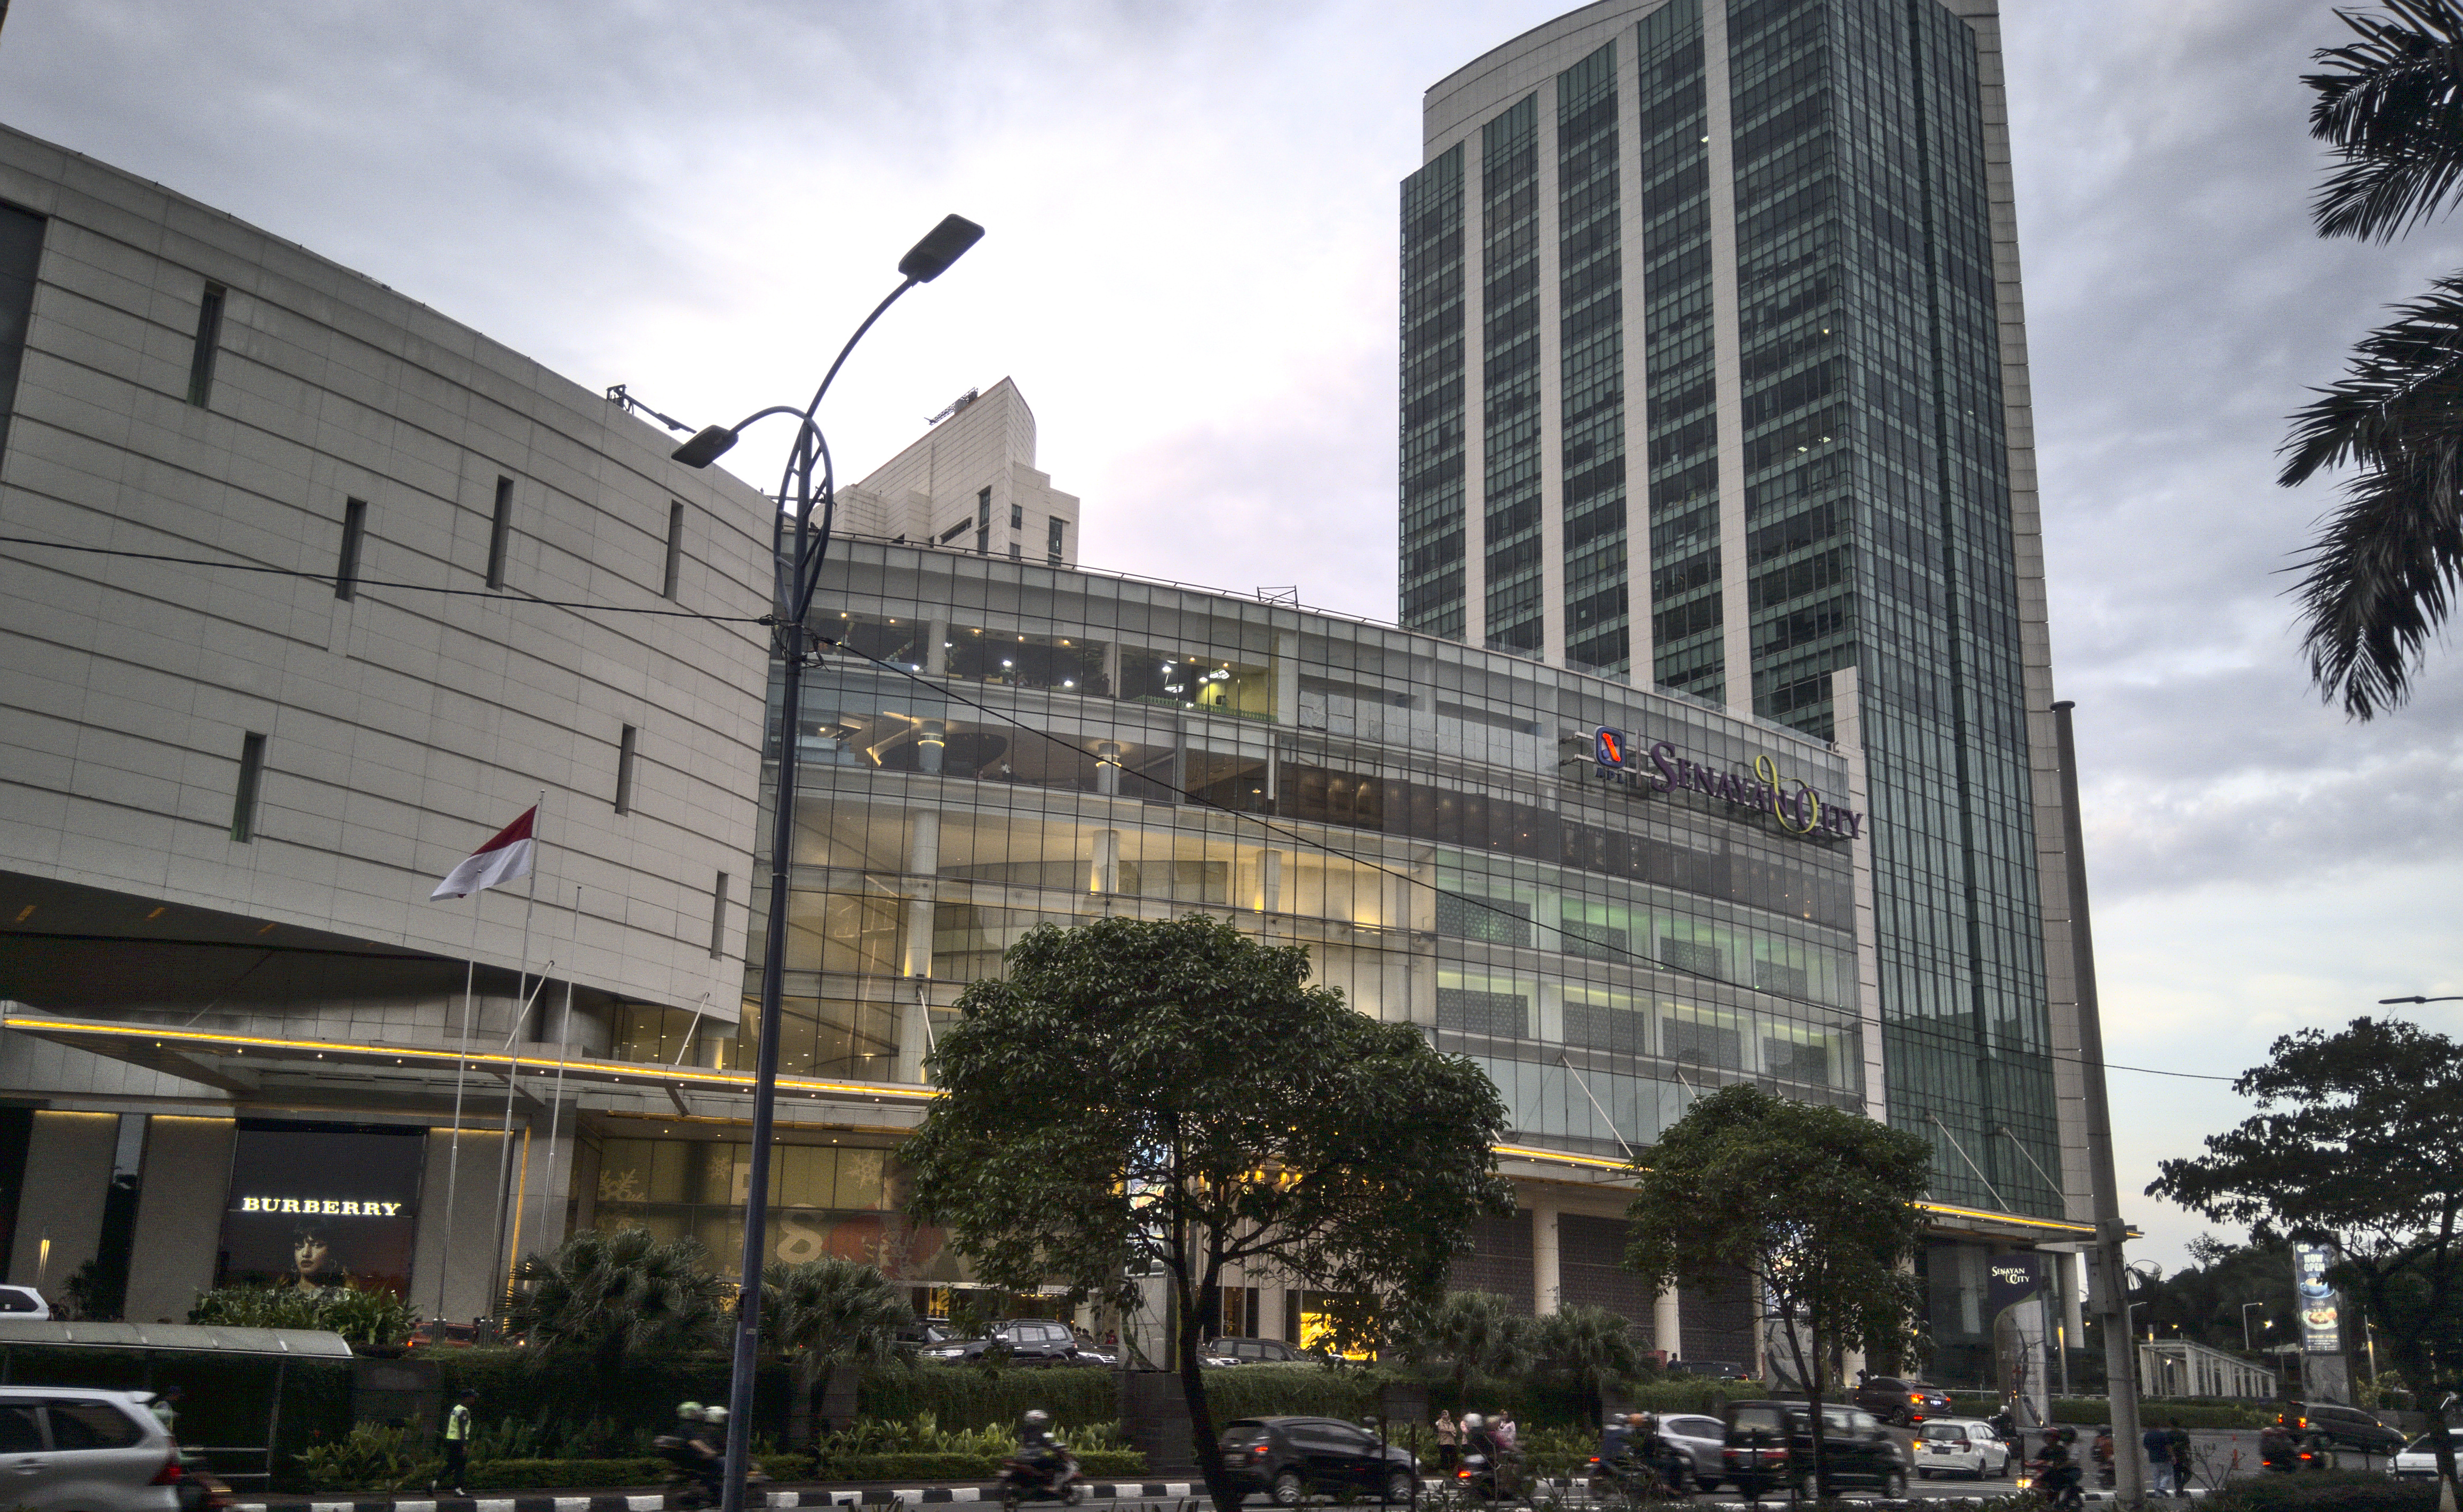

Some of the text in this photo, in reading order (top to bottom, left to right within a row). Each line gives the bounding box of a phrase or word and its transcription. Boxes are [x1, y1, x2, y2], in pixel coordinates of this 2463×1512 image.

[1650, 742, 1863, 839] SENAYAN CITY
[242, 1198, 401, 1215] BURBERRY
[2303, 1254, 2324, 1263] NOW
[1992, 1266, 2025, 1276] SENAYAN
[2303, 1262, 2325, 1272] OPEN
[2009, 1274, 2030, 1284] CITY
